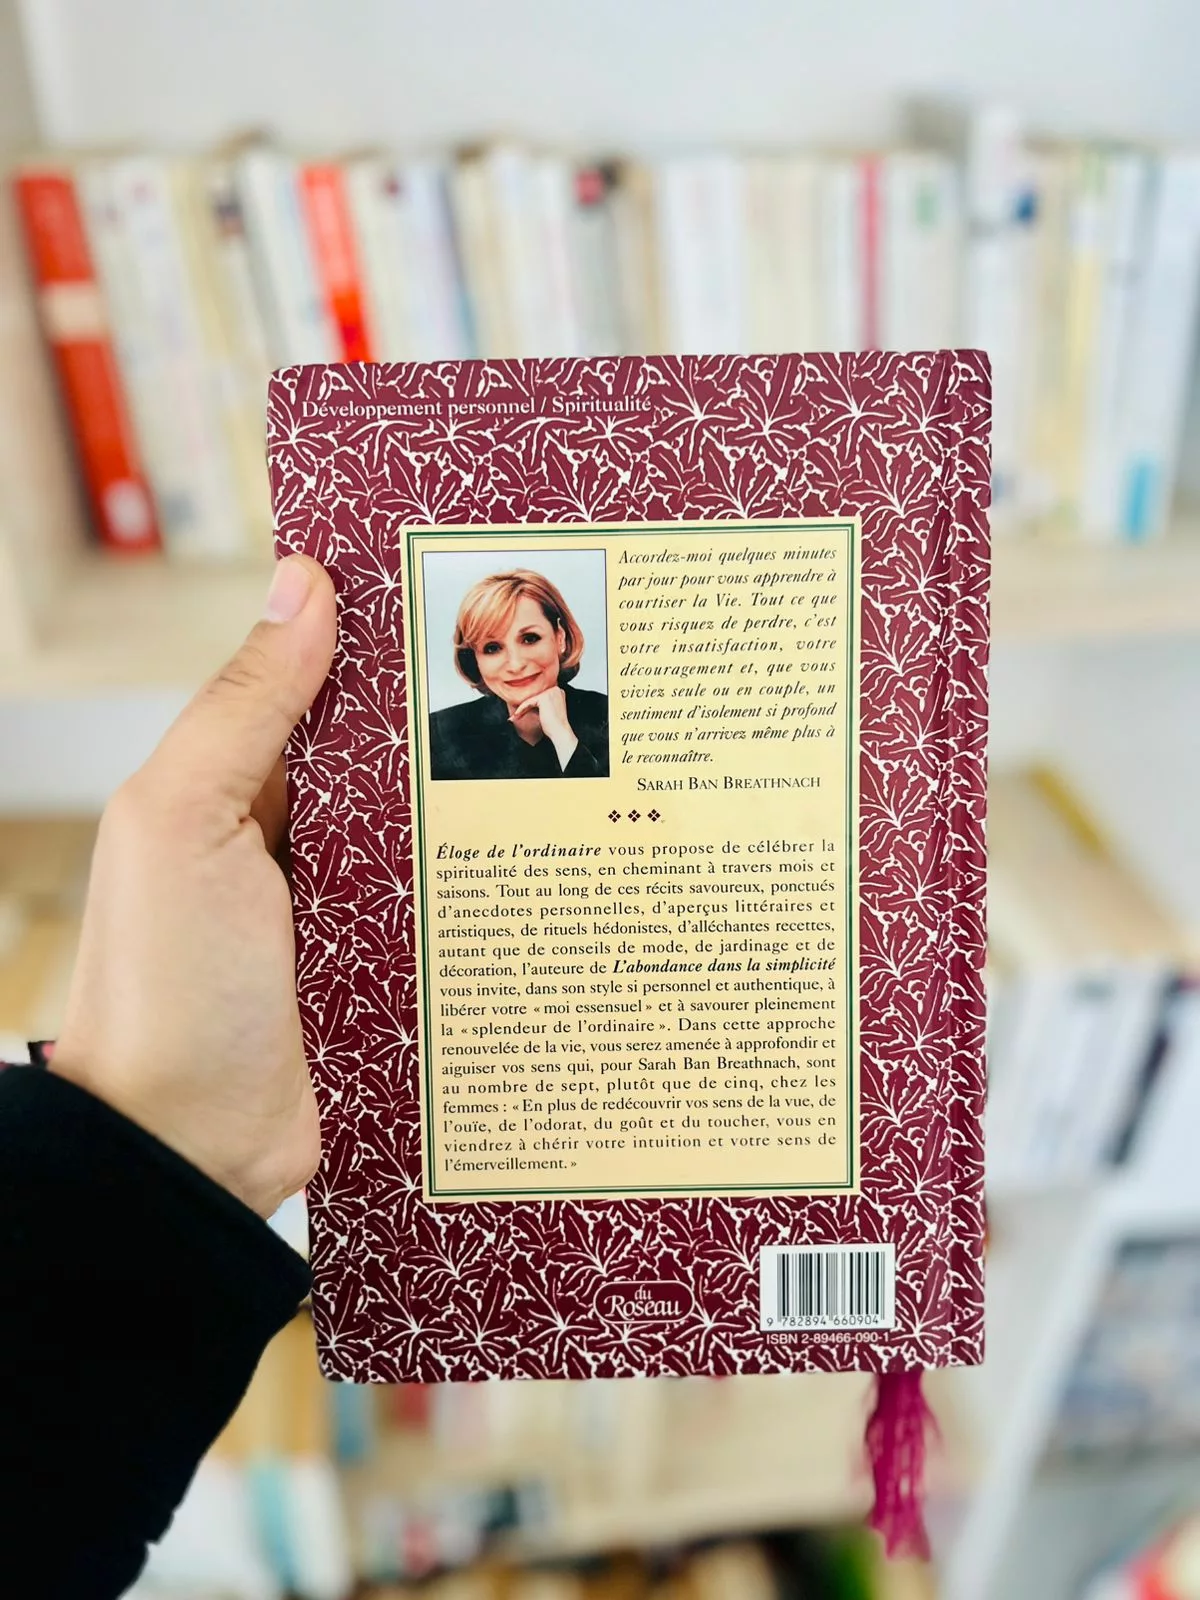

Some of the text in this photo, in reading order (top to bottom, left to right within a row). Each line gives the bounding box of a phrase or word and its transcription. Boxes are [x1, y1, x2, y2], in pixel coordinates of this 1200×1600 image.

[302, 400, 443, 419] Développement
[448, 397, 535, 417] personnel
[552, 396, 651, 416] Spiritualité
[619, 546, 836, 565] Accordez-moi quelques minutes
[618, 568, 836, 590] par jour pour vous apprendre à
[619, 592, 837, 609] courtiser la Vie. Tout ce que
[620, 614, 836, 634] vous risquez de perdre, c'est
[620, 637, 836, 655] votre insatisfaction, votre
[620, 662, 836, 679] découragement et, que vous
[621, 681, 835, 698] viviez seule ou en couple, un
[620, 702, 837, 720] sentiment d'isolement si profond
[621, 724, 835, 746] que vous n'arrivez même plus à
[622, 750, 713, 764] le reconnaître.
[637, 776, 820, 791] SARAH BAN BREATHNACH
[436, 839, 835, 862] Éloge de l'ordinaire vous propose de célébrer la
[436, 859, 835, 882] spiritualité des sens, en cheminant à travers mois et
[437, 879, 835, 899] saisons. Tout au long de ces récits savoureux, ponctués
[438, 899, 835, 920] d'anecdotes personnelles, d'aperçus littéraires et
[438, 920, 834, 941] artistiques, de rituels hédonistes, d'alléchantes recettes,
[439, 957, 836, 978] décoration, l'auteure de L'abondance dans la simplicité
[440, 977, 835, 998] vous invite, dans son style si personnel et authentique, à
[442, 1056, 836, 1078] aiguiser vos sens qui, pour Sarah Ban Breathnach, sont
[442, 1075, 836, 1095] au nombre de sept, plutôt que de cinq, chez les
[499, 1119, 517, 1132] de
[594, 1117, 612, 1130] du
[620, 1116, 653, 1132] goût
[660, 1119, 674, 1128] et
[682, 1115, 700, 1128] du
[708, 1114, 769, 1128] toucher,
[777, 1118, 811, 1126] vous
[818, 1117, 836, 1126] en
[444, 1132, 836, 1152] viendrez à chérir votre intuition et votre sens de
[634, 1284, 653, 1300] du
[604, 1295, 682, 1321] Roseau
[766, 1314, 879, 1327] 9 782894 660904
[766, 1332, 889, 1344] ISBN 2-89466-090-1
